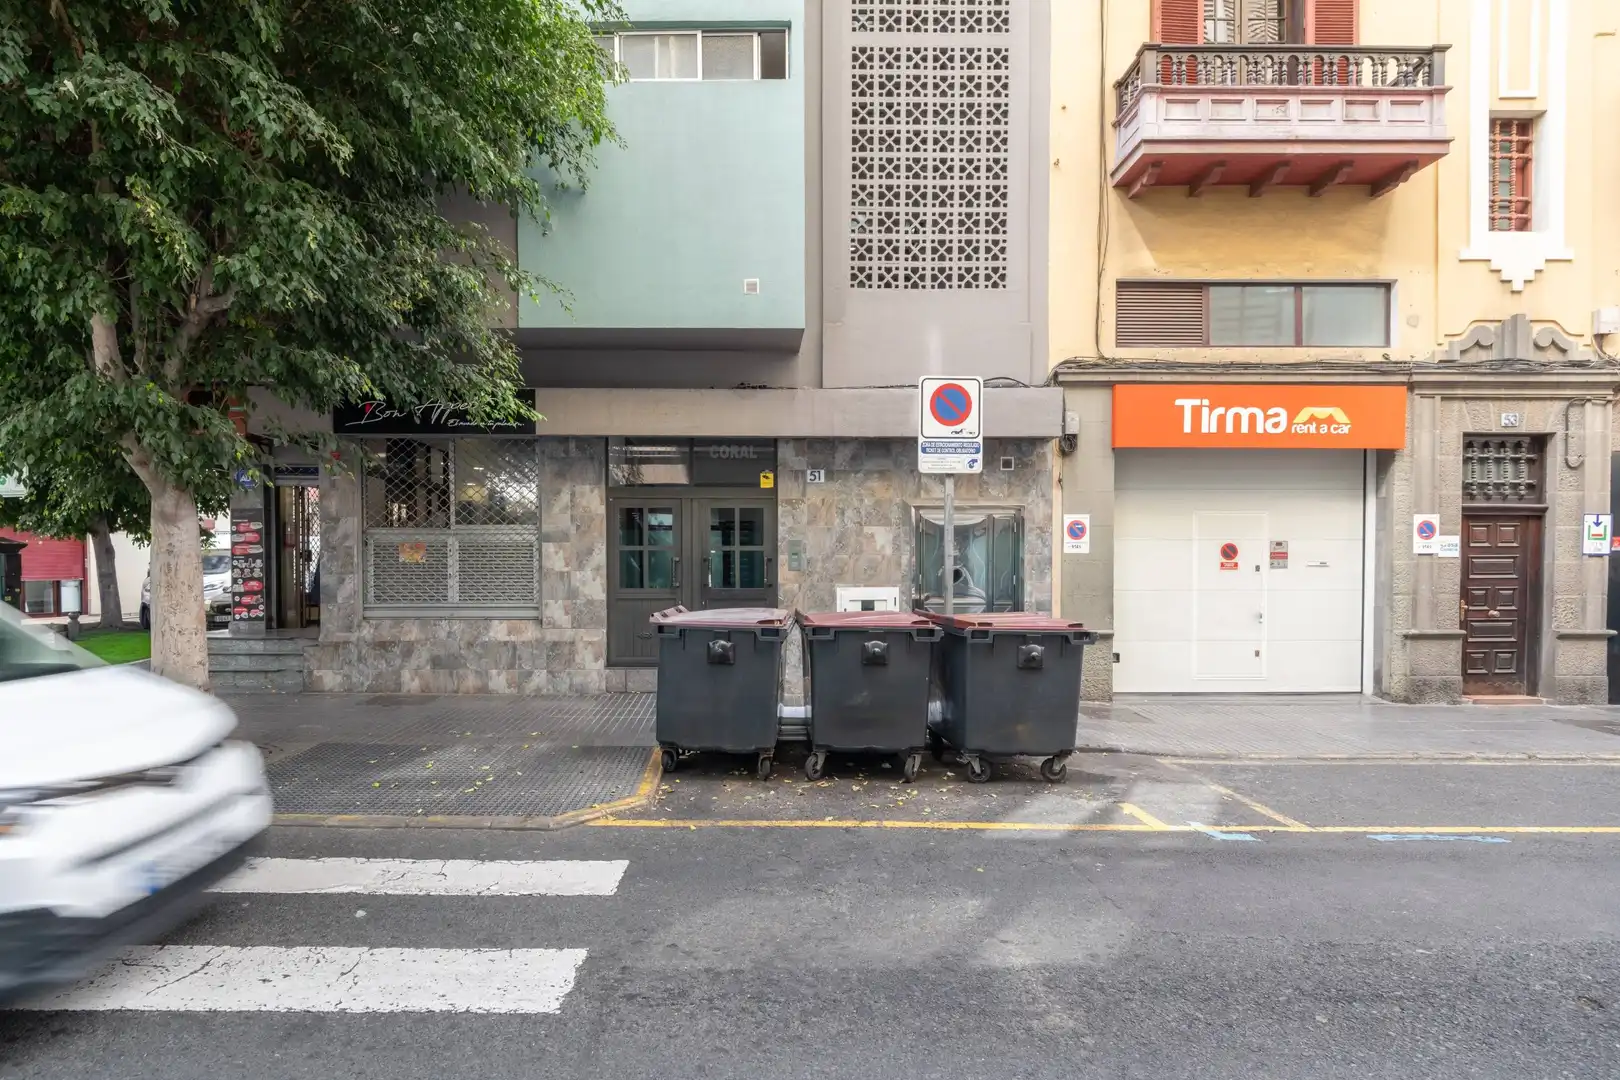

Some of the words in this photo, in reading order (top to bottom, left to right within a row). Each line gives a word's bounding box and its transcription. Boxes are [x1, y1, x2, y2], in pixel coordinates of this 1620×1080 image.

[345, 400, 407, 425] Bon
[1174, 398, 1288, 434] Tirma
[1291, 423, 1317, 434] rent
[1319, 425, 1328, 434] a
[1330, 424, 1351, 434] car
[1503, 414, 1517, 426] 53
[710, 445, 758, 459] CORAL
[809, 470, 821, 482] 51
